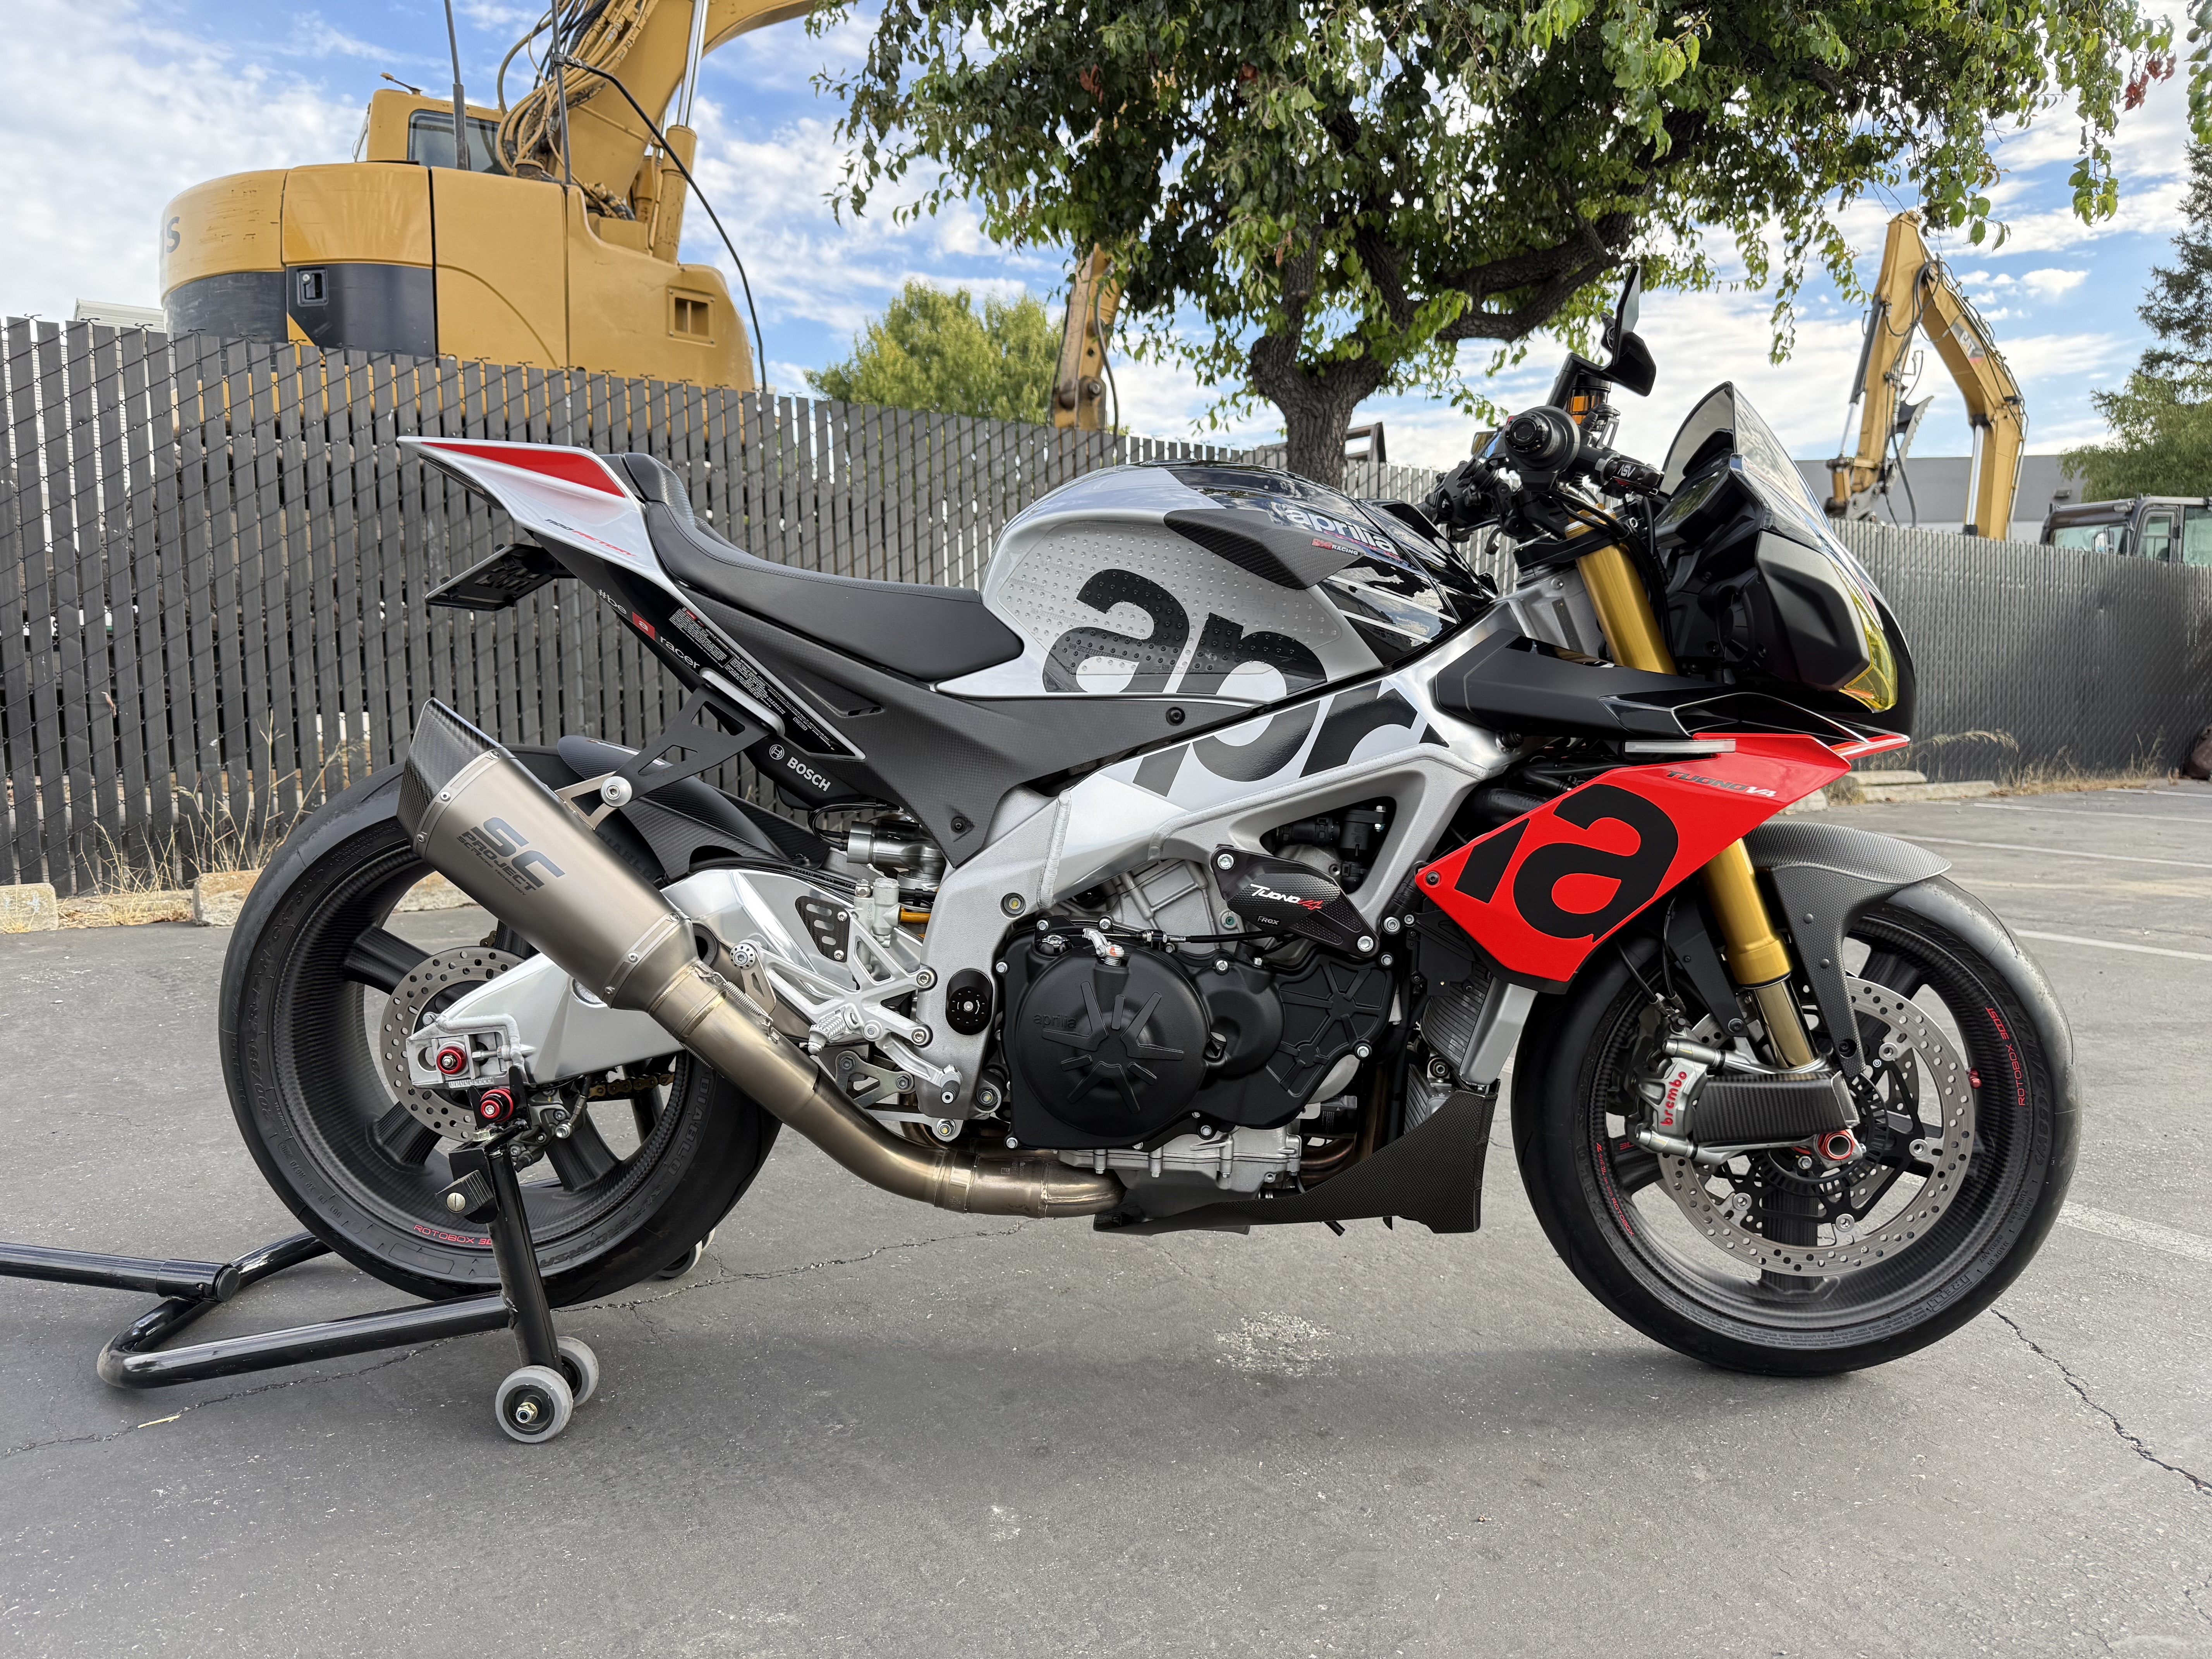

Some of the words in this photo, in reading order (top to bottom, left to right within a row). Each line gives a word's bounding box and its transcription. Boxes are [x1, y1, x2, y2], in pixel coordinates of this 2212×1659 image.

[1960, 330, 1975, 357] CAT
[1617, 464, 1636, 477] ASV
[1286, 509, 1398, 555] aprilia
[598, 589, 627, 614] #be
[660, 636, 700, 668] racer
[787, 757, 831, 792] BOSCH
[462, 831, 536, 891] PROJECT
[471, 817, 565, 888] SC
[495, 869, 526, 895] TECHNOLOGY
[1034, 1013, 1076, 1029] aprilia
[2006, 1043, 2025, 1106] ROTOBOX
[1661, 1071, 1687, 1126] brembo
[668, 1077, 711, 1176] DIABLO
[414, 1224, 474, 1244] ROTOBOX
[1612, 1197, 1634, 1236] ROTOBOX
